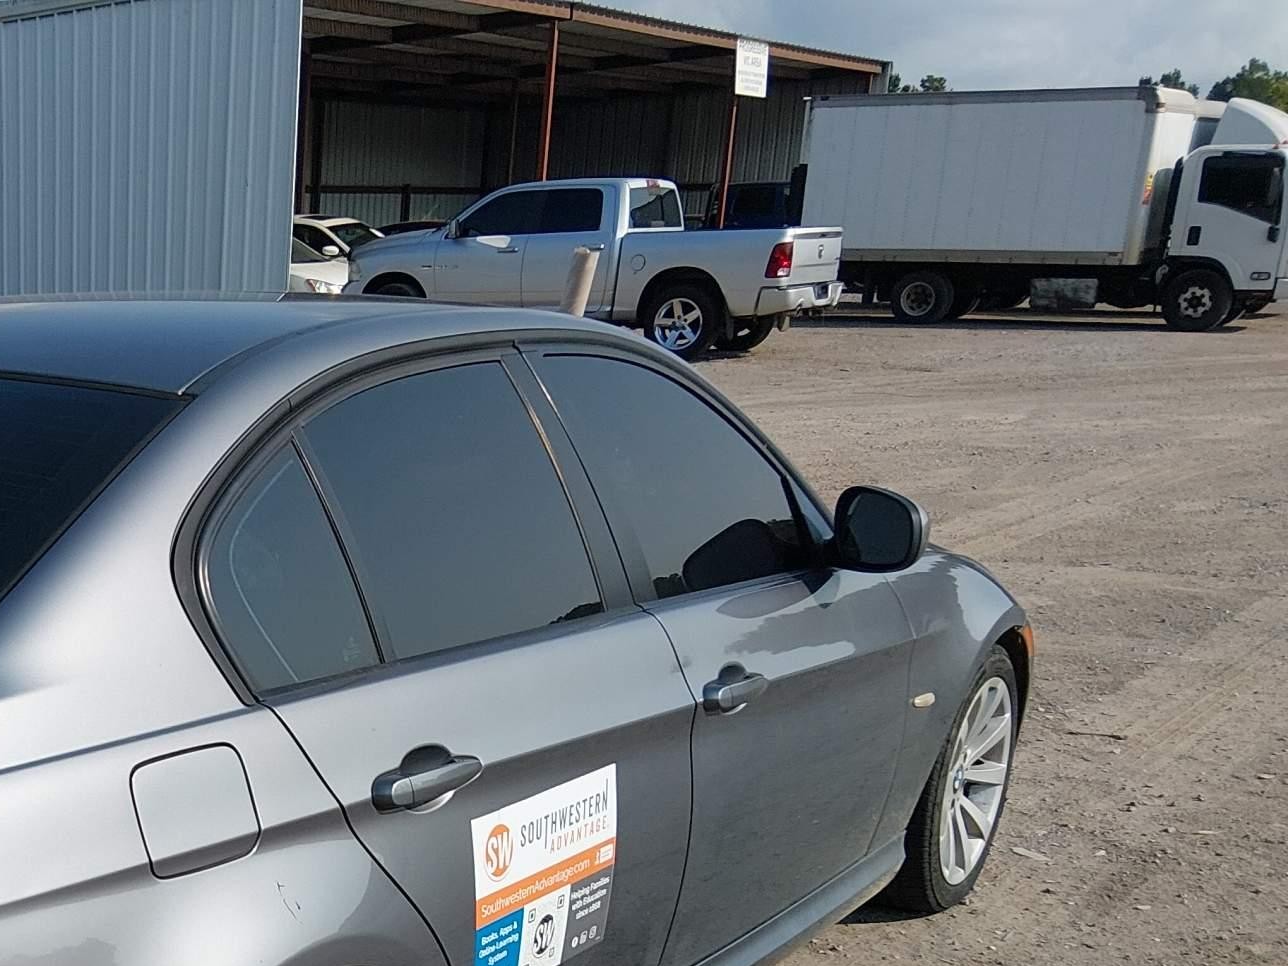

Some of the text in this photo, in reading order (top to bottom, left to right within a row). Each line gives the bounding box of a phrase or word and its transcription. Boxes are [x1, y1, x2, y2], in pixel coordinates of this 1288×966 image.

[520, 778, 608, 848] SOUTHWESTERN
[487, 831, 511, 873] SW
[550, 815, 608, 854] ADVANTAGE
[481, 859, 590, 918] SouthwesternAdvantage.com
[533, 919, 554, 954] SW
